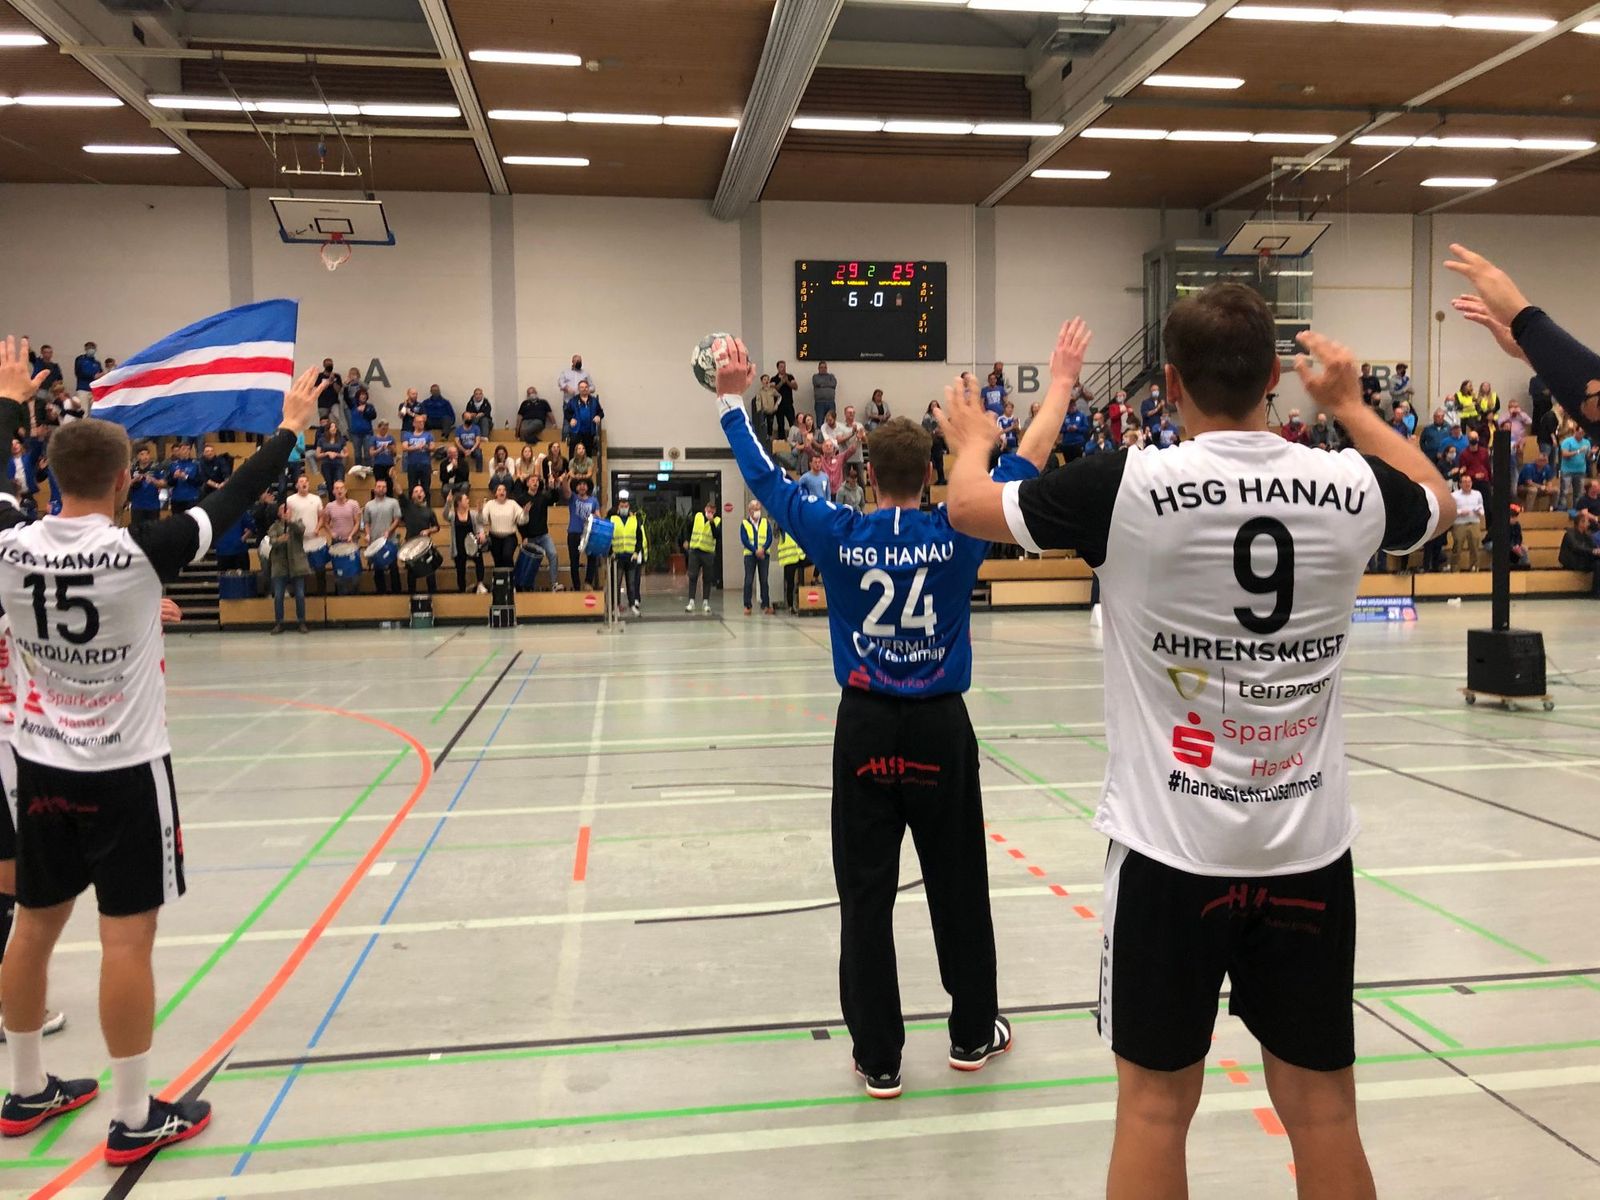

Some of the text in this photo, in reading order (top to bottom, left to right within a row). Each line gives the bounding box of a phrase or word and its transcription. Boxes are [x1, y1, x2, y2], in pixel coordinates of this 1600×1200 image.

[836, 263, 858, 279] 29
[867, 265, 876, 277] 2
[892, 263, 915, 280] 25
[364, 358, 391, 388] A
[1018, 366, 1040, 393] B
[1150, 478, 1365, 516] HSG HANAU
[44, 552, 132, 570] HANAU
[838, 541, 953, 566] HSG HANAU
[1233, 516, 1294, 634] 9
[23, 572, 100, 645] 15
[859, 567, 937, 637] 24
